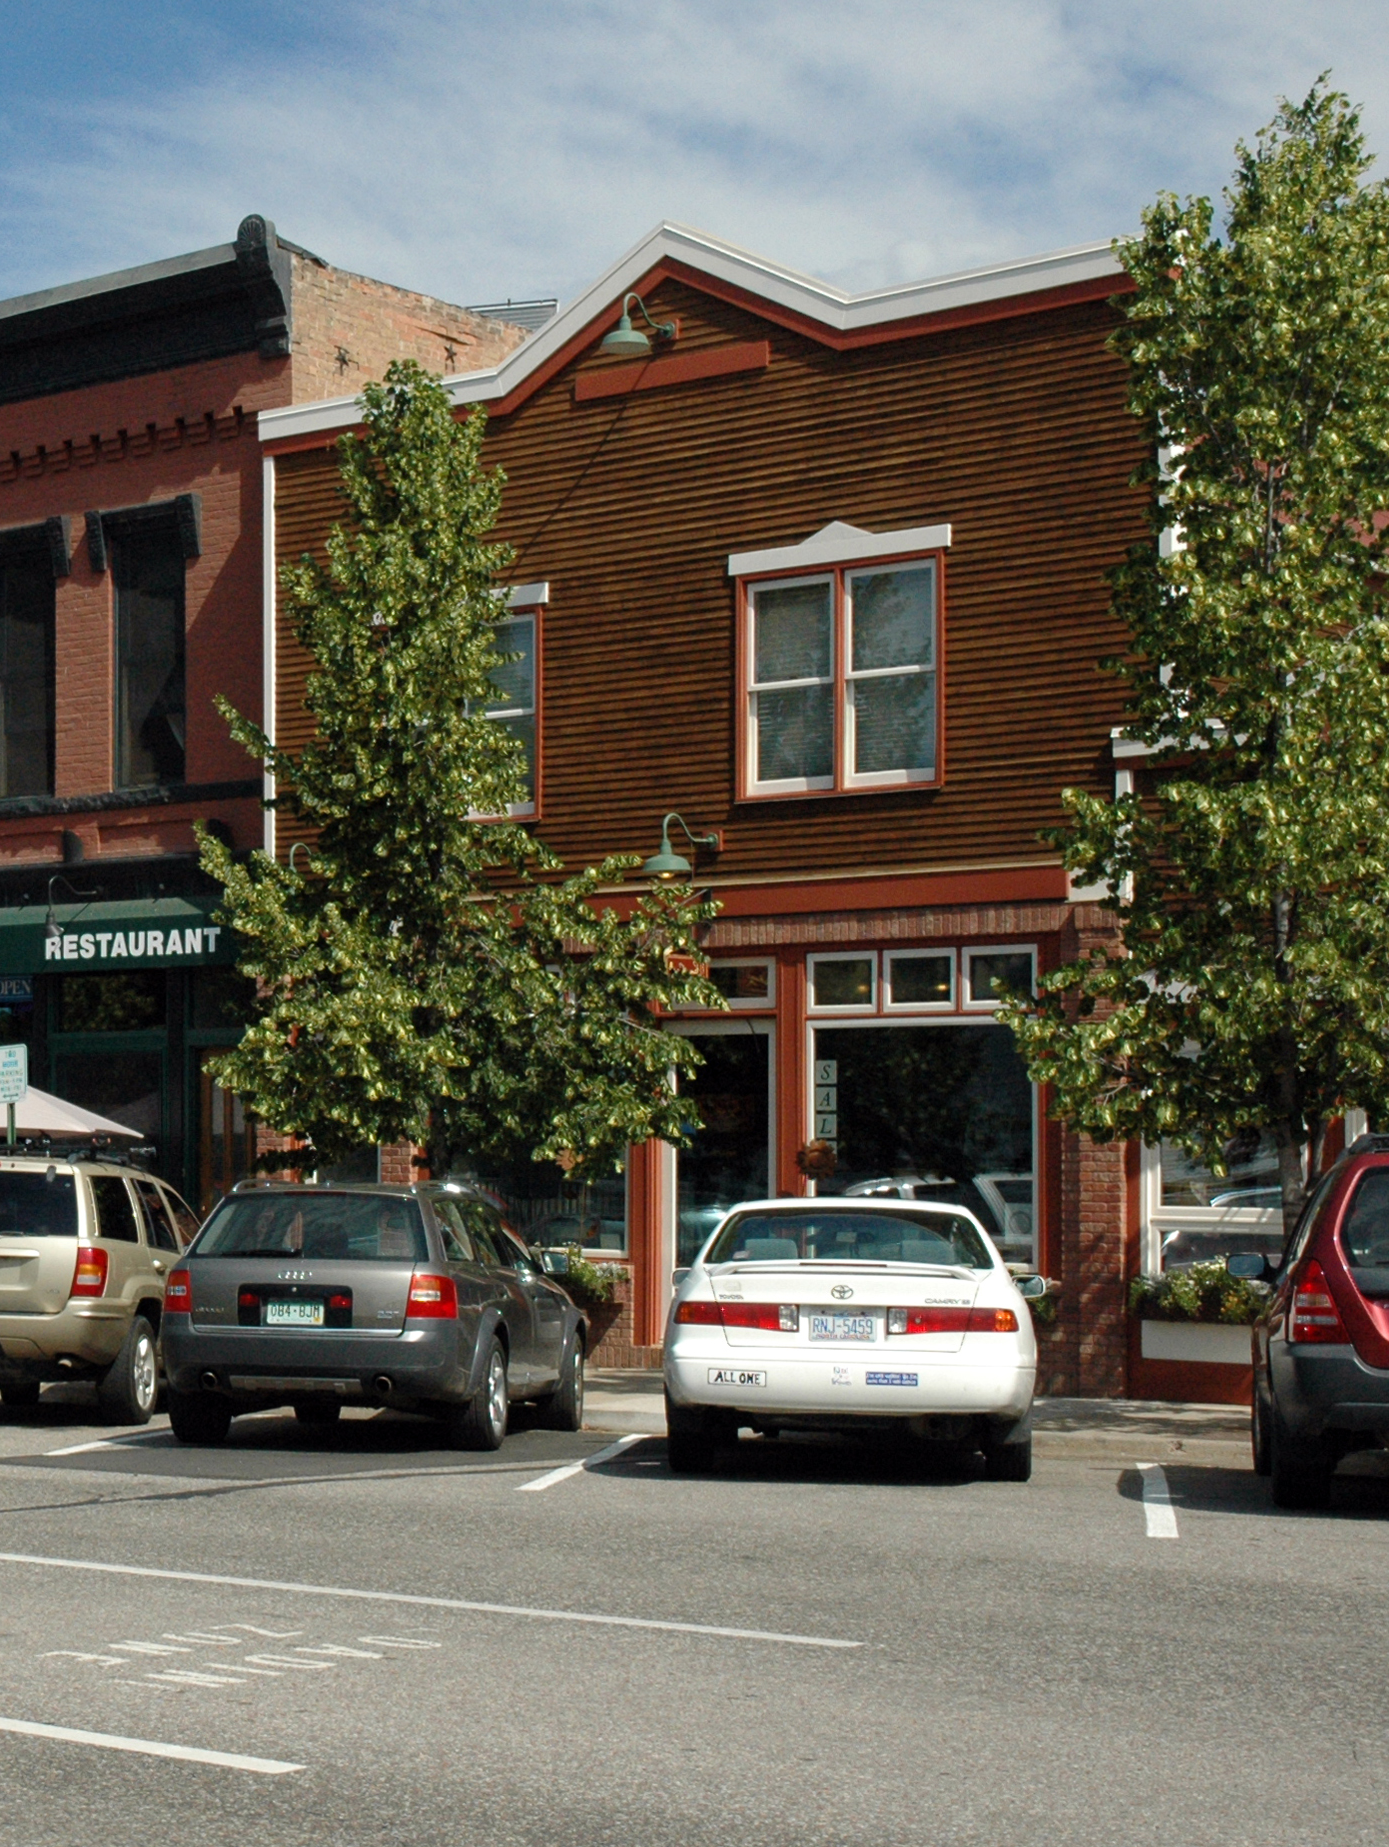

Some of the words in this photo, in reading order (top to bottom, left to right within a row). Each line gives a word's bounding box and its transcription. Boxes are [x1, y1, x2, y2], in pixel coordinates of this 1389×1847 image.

[45, 927, 221, 959] RESTAURANT
[819, 1063, 833, 1135] SAL
[812, 1317, 873, 1335] RNJ-5459
[714, 1371, 736, 1383] ALL
[739, 1373, 761, 1385] ONE
